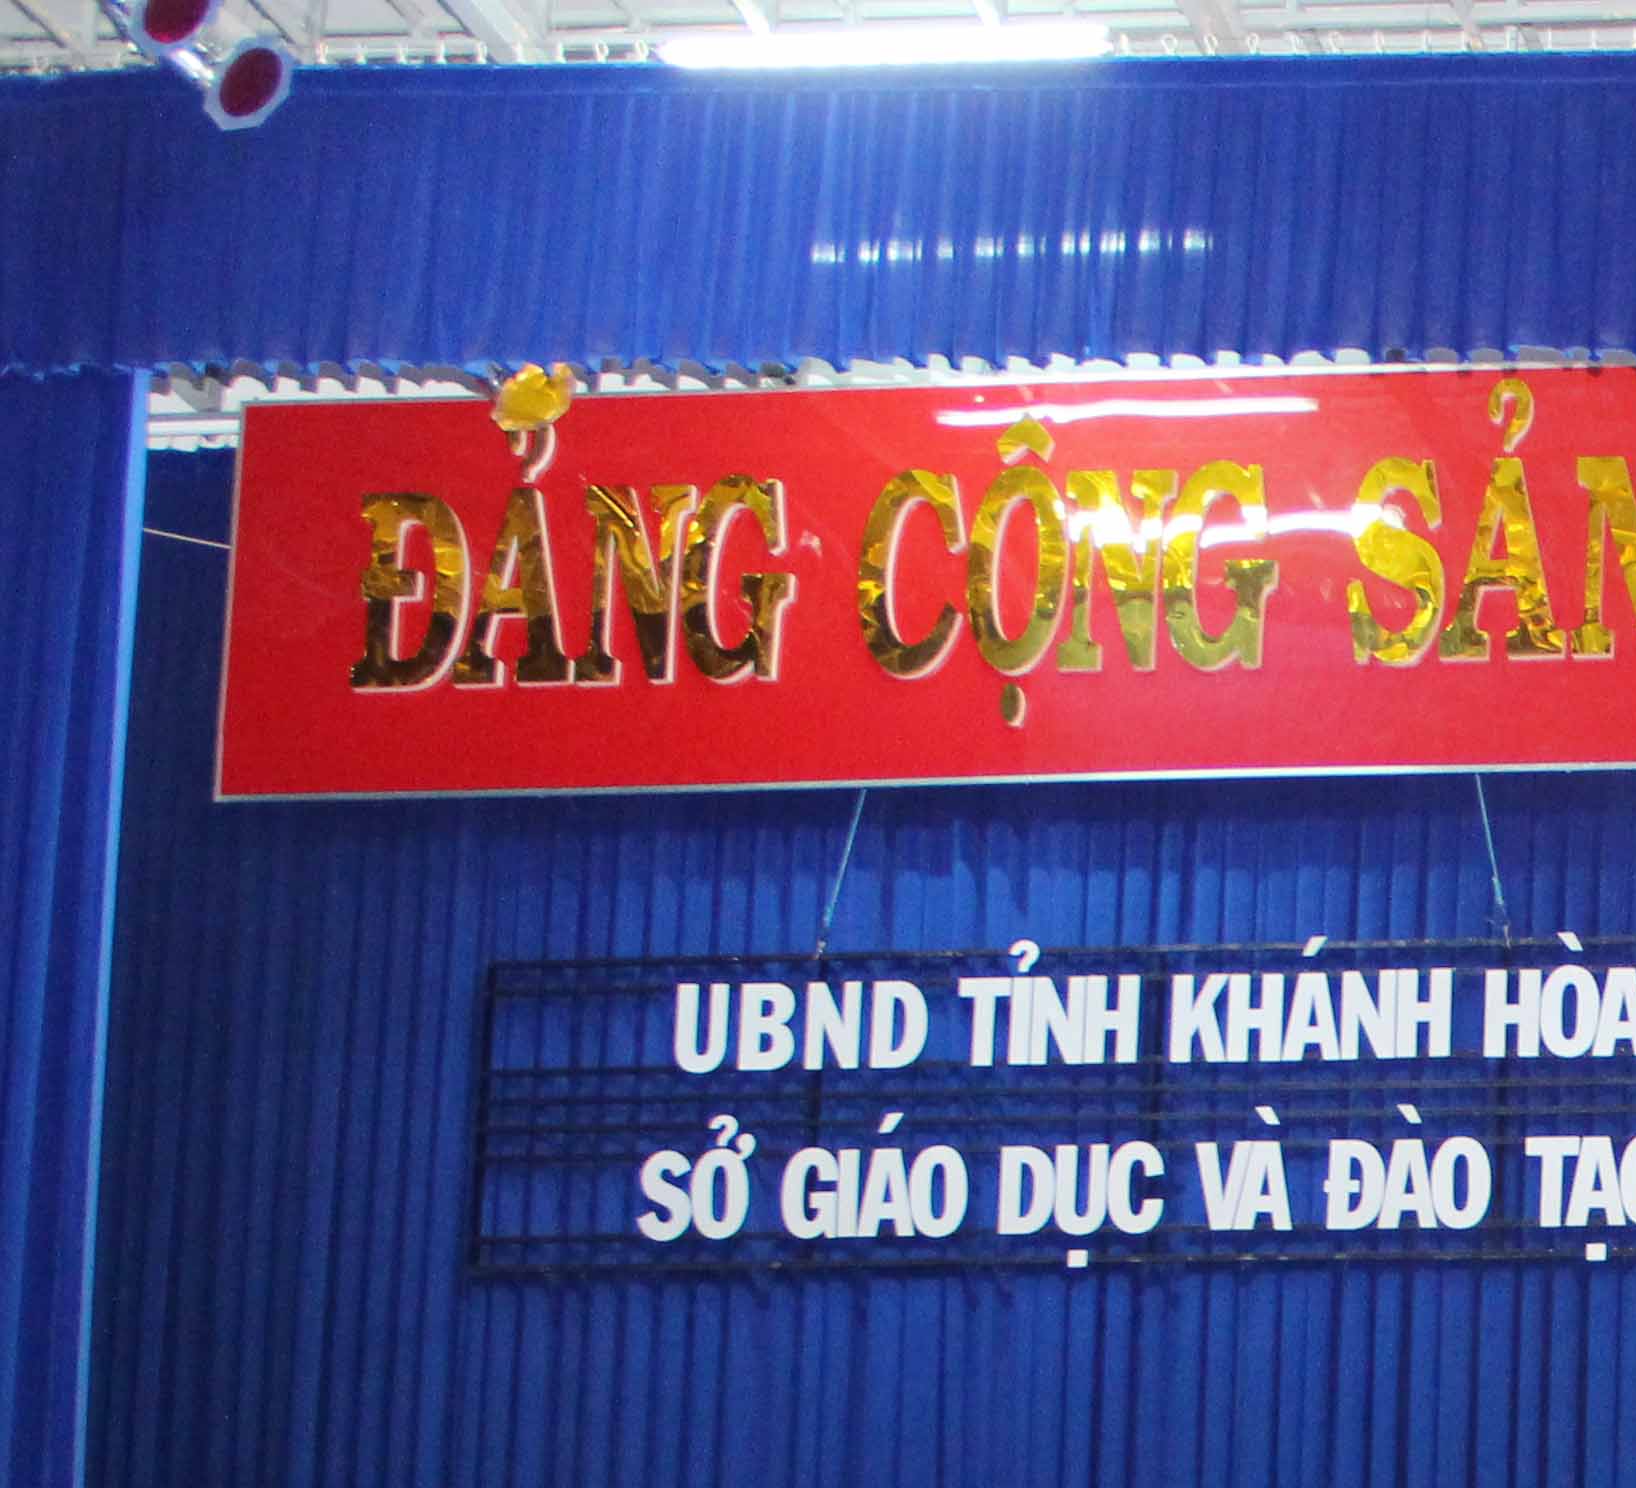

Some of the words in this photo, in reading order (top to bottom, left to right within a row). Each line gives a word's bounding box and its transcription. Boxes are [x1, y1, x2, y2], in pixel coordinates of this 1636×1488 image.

[350, 424, 793, 690] ĐẢNG
[859, 414, 1279, 728] CỘNG
[675, 981, 927, 1072] UBND
[959, 940, 1140, 1065] TỈNH
[1170, 936, 1452, 1062] KHÁNH
[638, 1115, 754, 1241] SỞ
[782, 1113, 966, 1238] GIÁO
[999, 1141, 1163, 1267] DỤC
[1196, 1107, 1291, 1230] VÀ
[1324, 1105, 1490, 1229] ĐÀO
